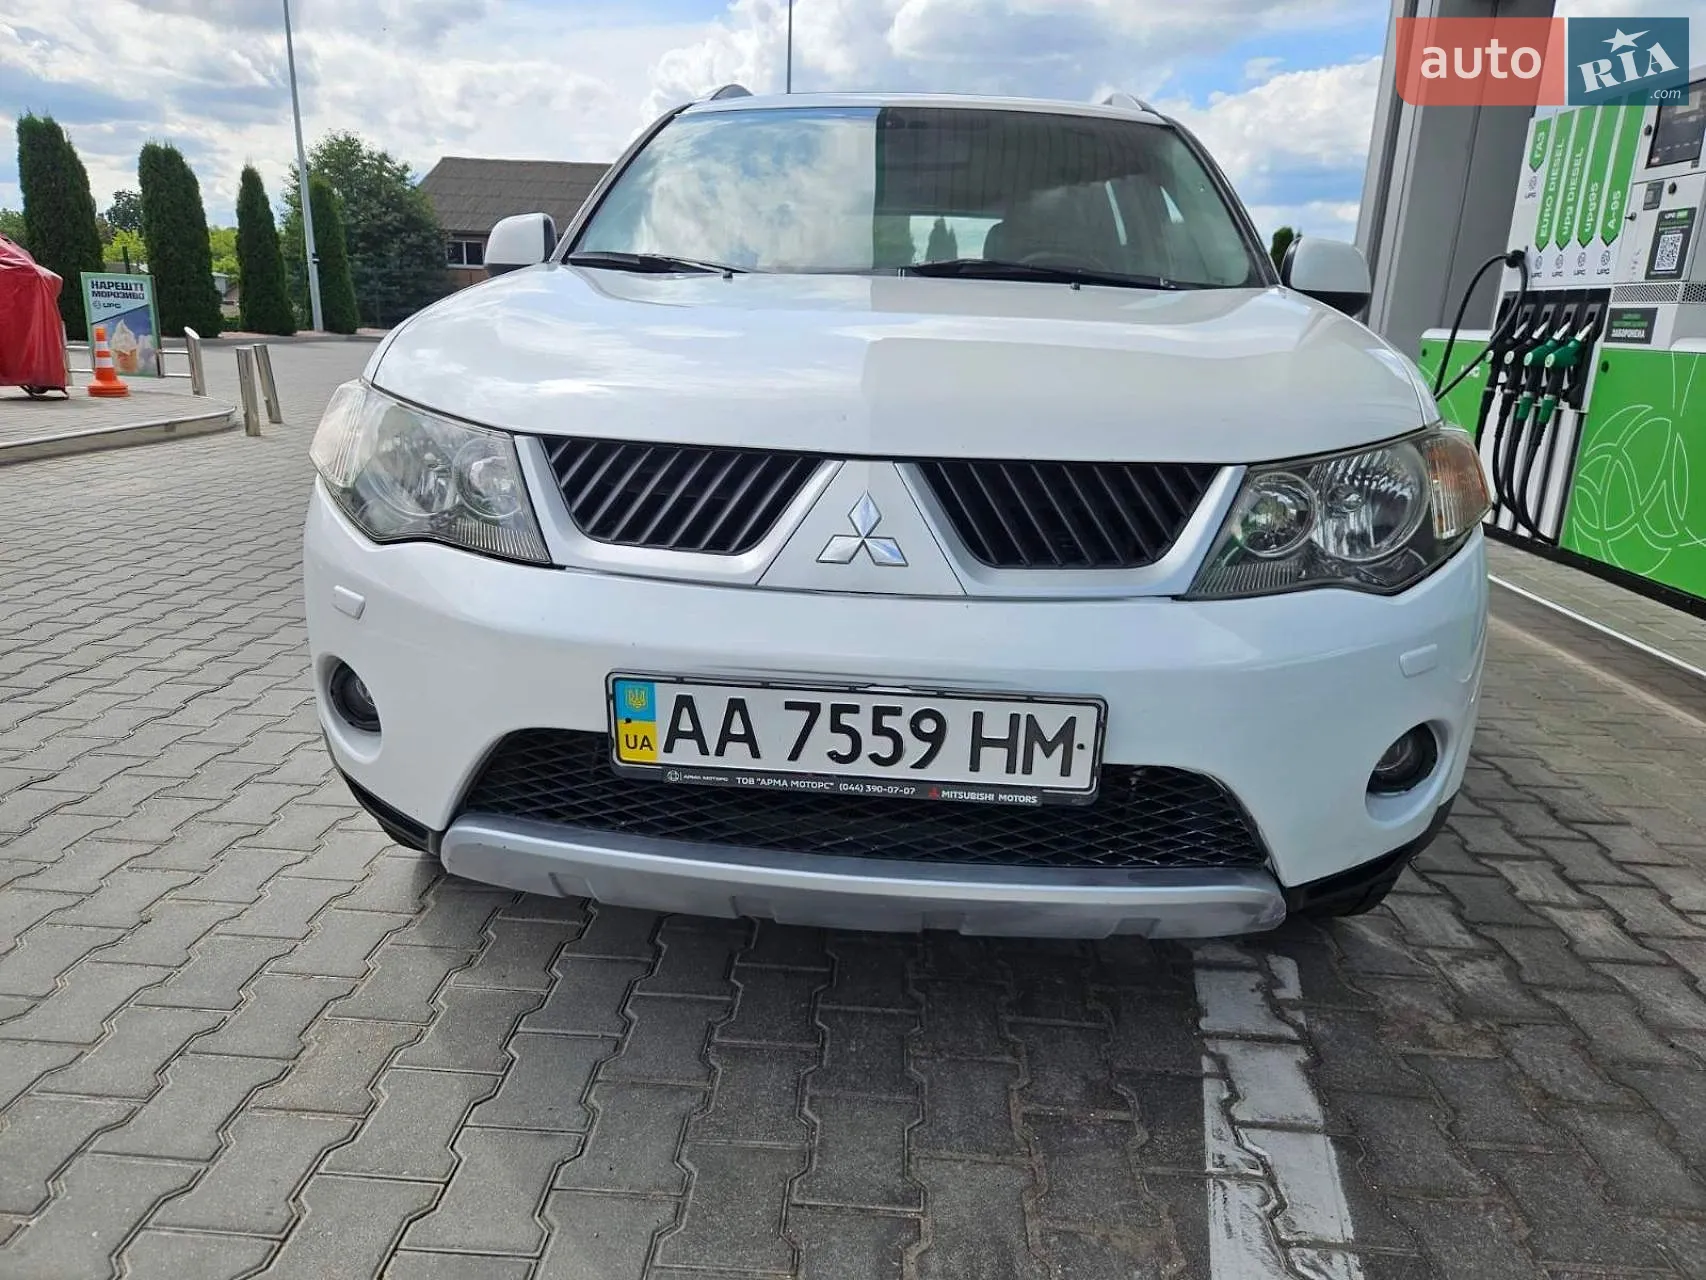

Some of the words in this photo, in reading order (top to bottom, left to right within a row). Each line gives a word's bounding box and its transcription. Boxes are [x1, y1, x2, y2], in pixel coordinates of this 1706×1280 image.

[1568, 147, 1584, 202] DIESEL
[1540, 196, 1553, 238] EURO
[1549, 138, 1565, 192] DIESEL
[91, 280, 144, 291] НАРЕШТІ
[92, 291, 145, 300] МОРОЗИВО
[624, 733, 654, 751] UA
[663, 694, 761, 759] AA
[784, 701, 947, 770] 7559
[969, 711, 1077, 777] HM
[736, 777, 755, 785] ТОВ
[839, 783, 864, 793] (044)
[865, 784, 916, 796] 390-07-07
[941, 790, 995, 801] MITSUBISHI
[998, 794, 1039, 804] MOTORS
